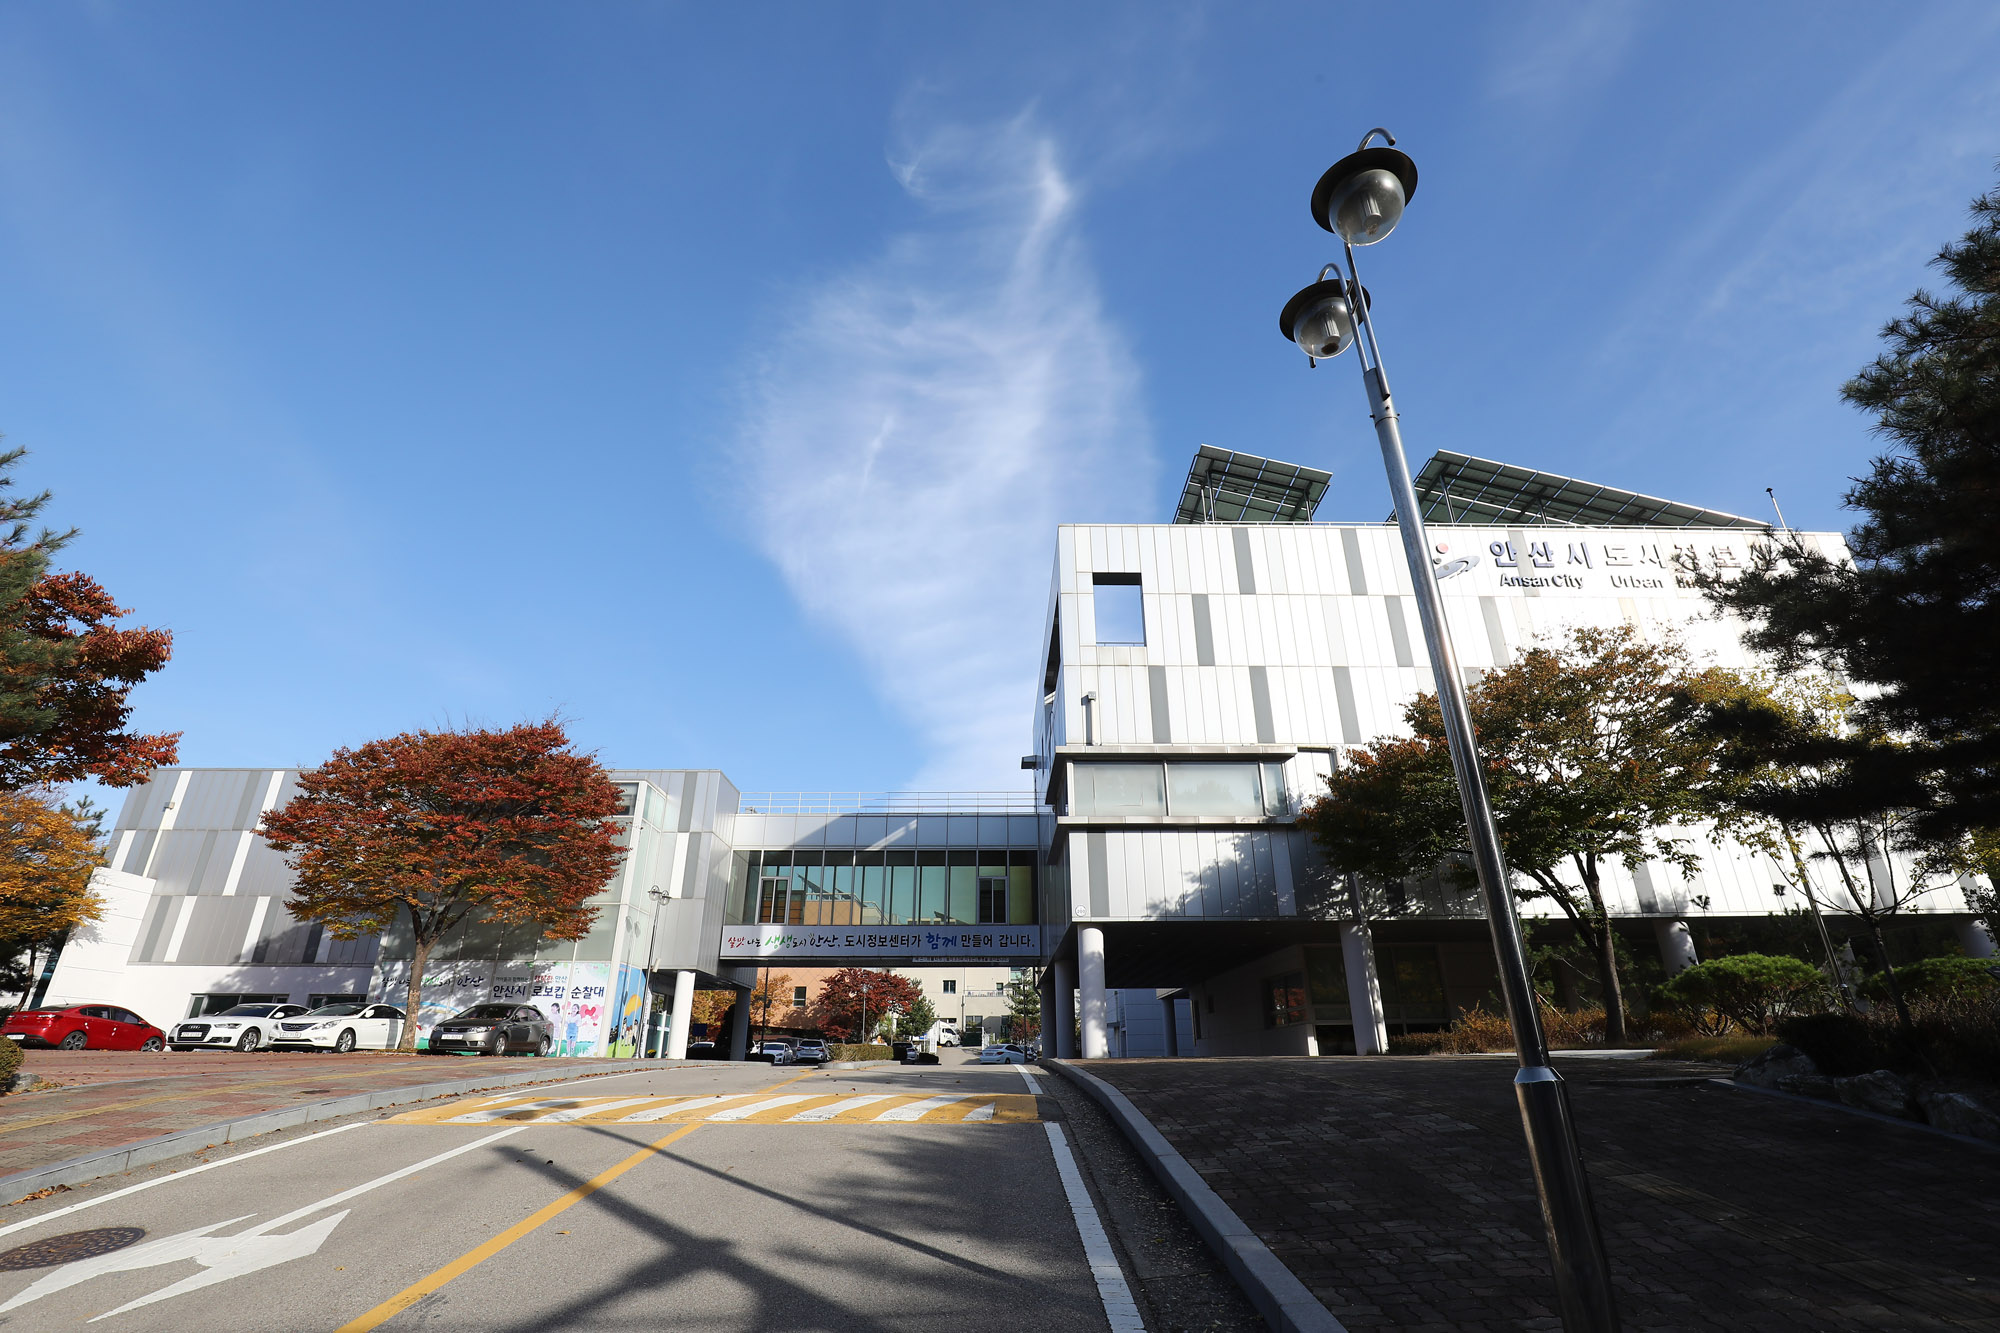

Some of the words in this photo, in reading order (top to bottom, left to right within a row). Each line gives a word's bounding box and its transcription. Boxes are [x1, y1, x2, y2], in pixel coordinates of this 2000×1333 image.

[1500, 573, 1550, 588] Ansan
[1551, 574, 1584, 590] City
[1610, 574, 1664, 589] Urban
[727, 936, 745, 949] 살맛
[747, 937, 762, 948] 나는
[809, 932, 841, 948] 안산,
[844, 933, 922, 948] 도시정보센터가
[925, 932, 958, 950] 함께
[961, 933, 994, 948] 만들어
[998, 933, 1036, 948] 갑니다.
[456, 975, 484, 987] 안산
[493, 985, 527, 998] 안산시
[531, 985, 566, 999] 로보캅
[570, 986, 605, 999] 순찰대
